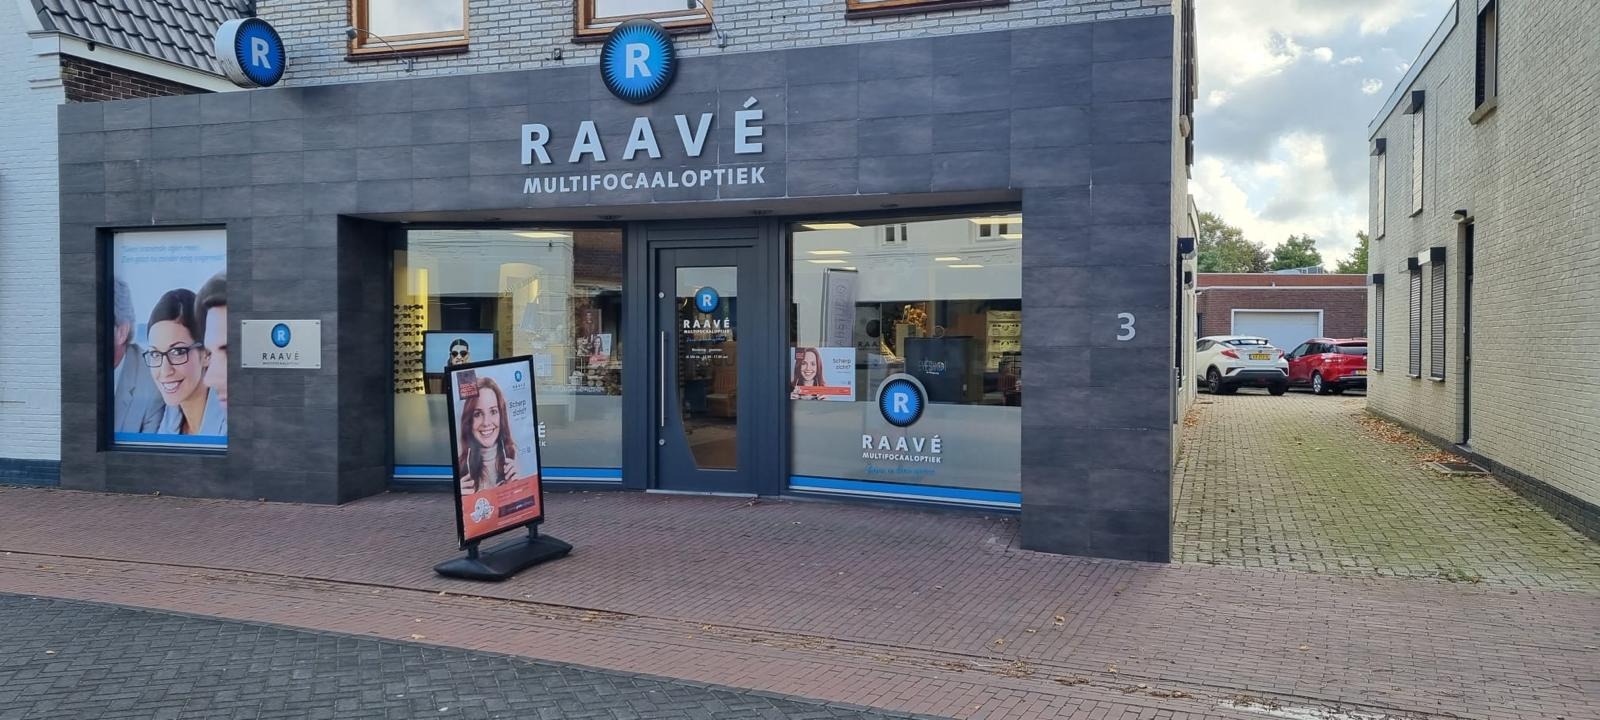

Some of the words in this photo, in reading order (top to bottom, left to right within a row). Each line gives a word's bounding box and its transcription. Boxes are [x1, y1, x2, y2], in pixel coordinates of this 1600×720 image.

[251, 36, 272, 69] R
[626, 42, 652, 79] R
[521, 96, 763, 165] RAAVÉ
[523, 166, 766, 194] MULTIFOCAALOPTIEK
[702, 294, 712, 307] R
[683, 317, 730, 328] RAAVÉ
[1116, 312, 1136, 341] 3
[277, 330, 286, 341] R
[893, 392, 910, 413] R
[862, 434, 941, 453] RAAVÉ
[862, 452, 941, 463] MULTIFOCAALOPTIEK
